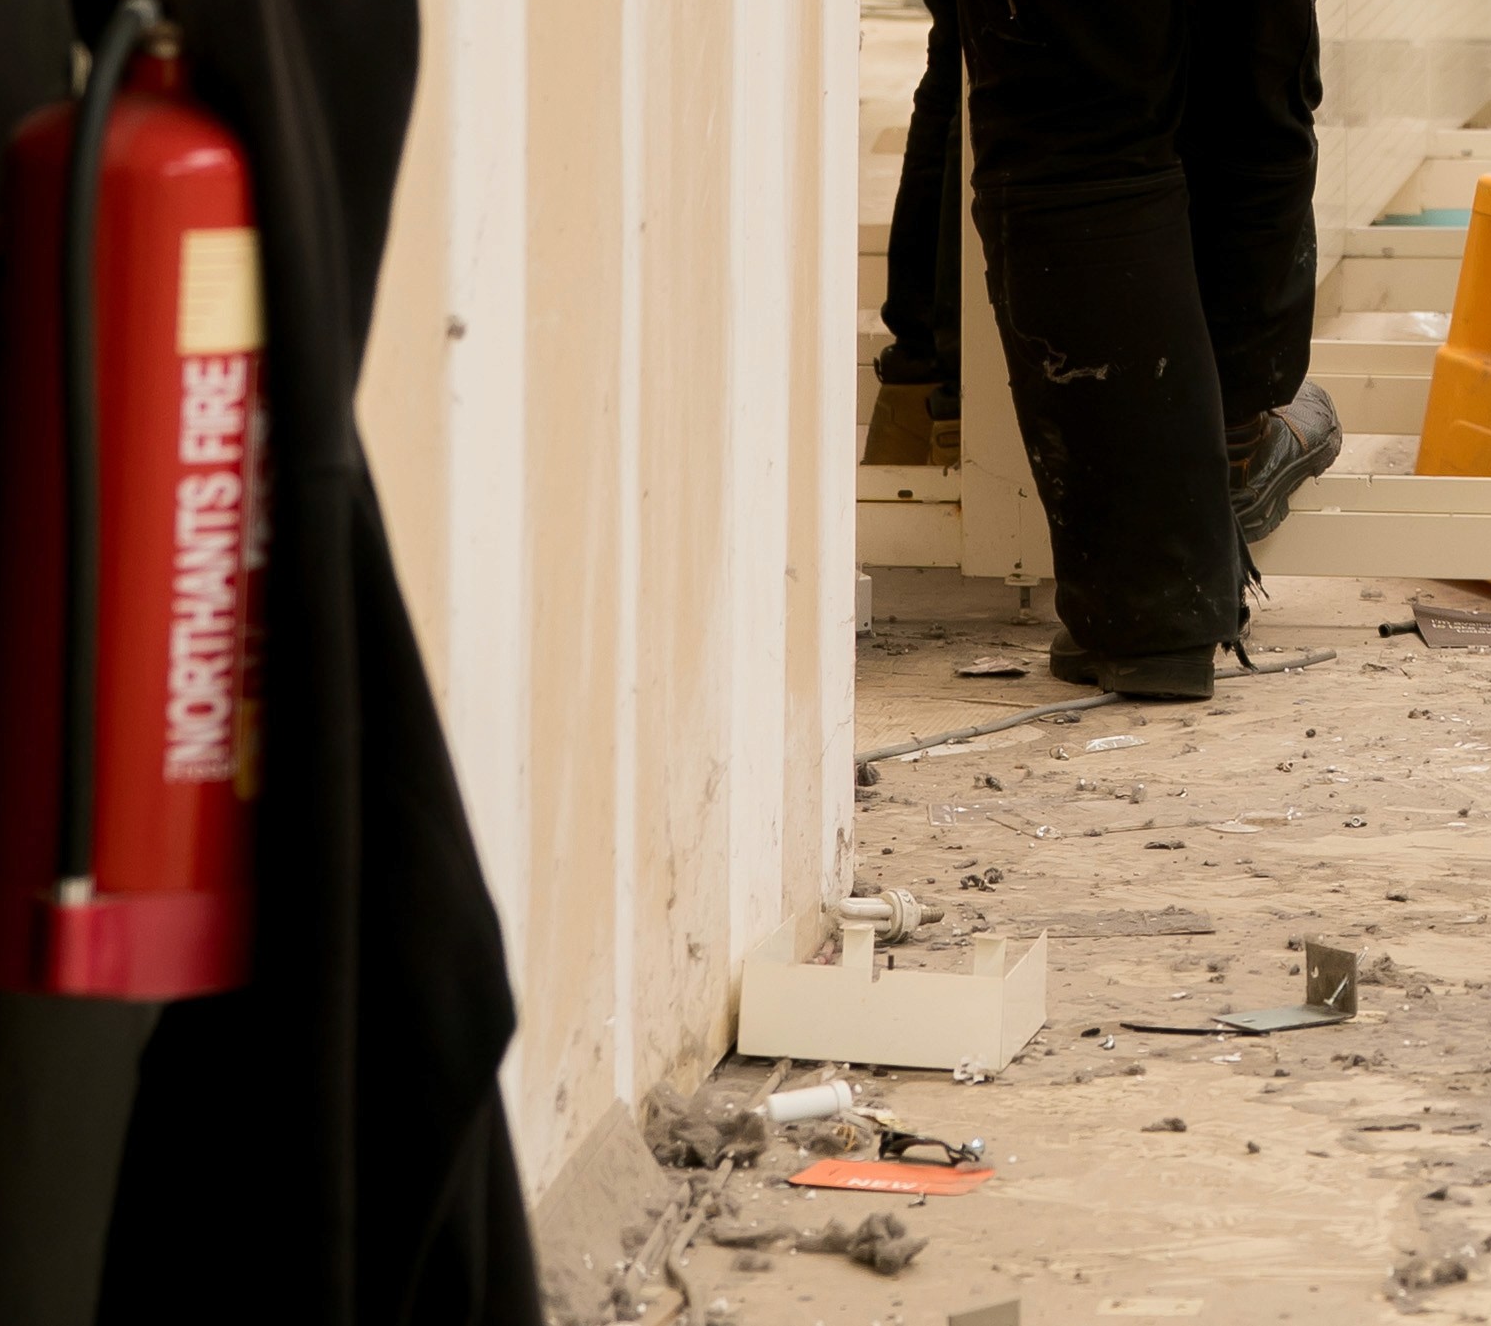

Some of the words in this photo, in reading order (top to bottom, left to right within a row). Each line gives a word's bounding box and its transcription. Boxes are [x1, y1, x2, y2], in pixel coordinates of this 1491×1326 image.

[178, 353, 246, 465] FIRE
[165, 470, 241, 763] NORTHANTS
[846, 1177, 918, 1190] NEW
